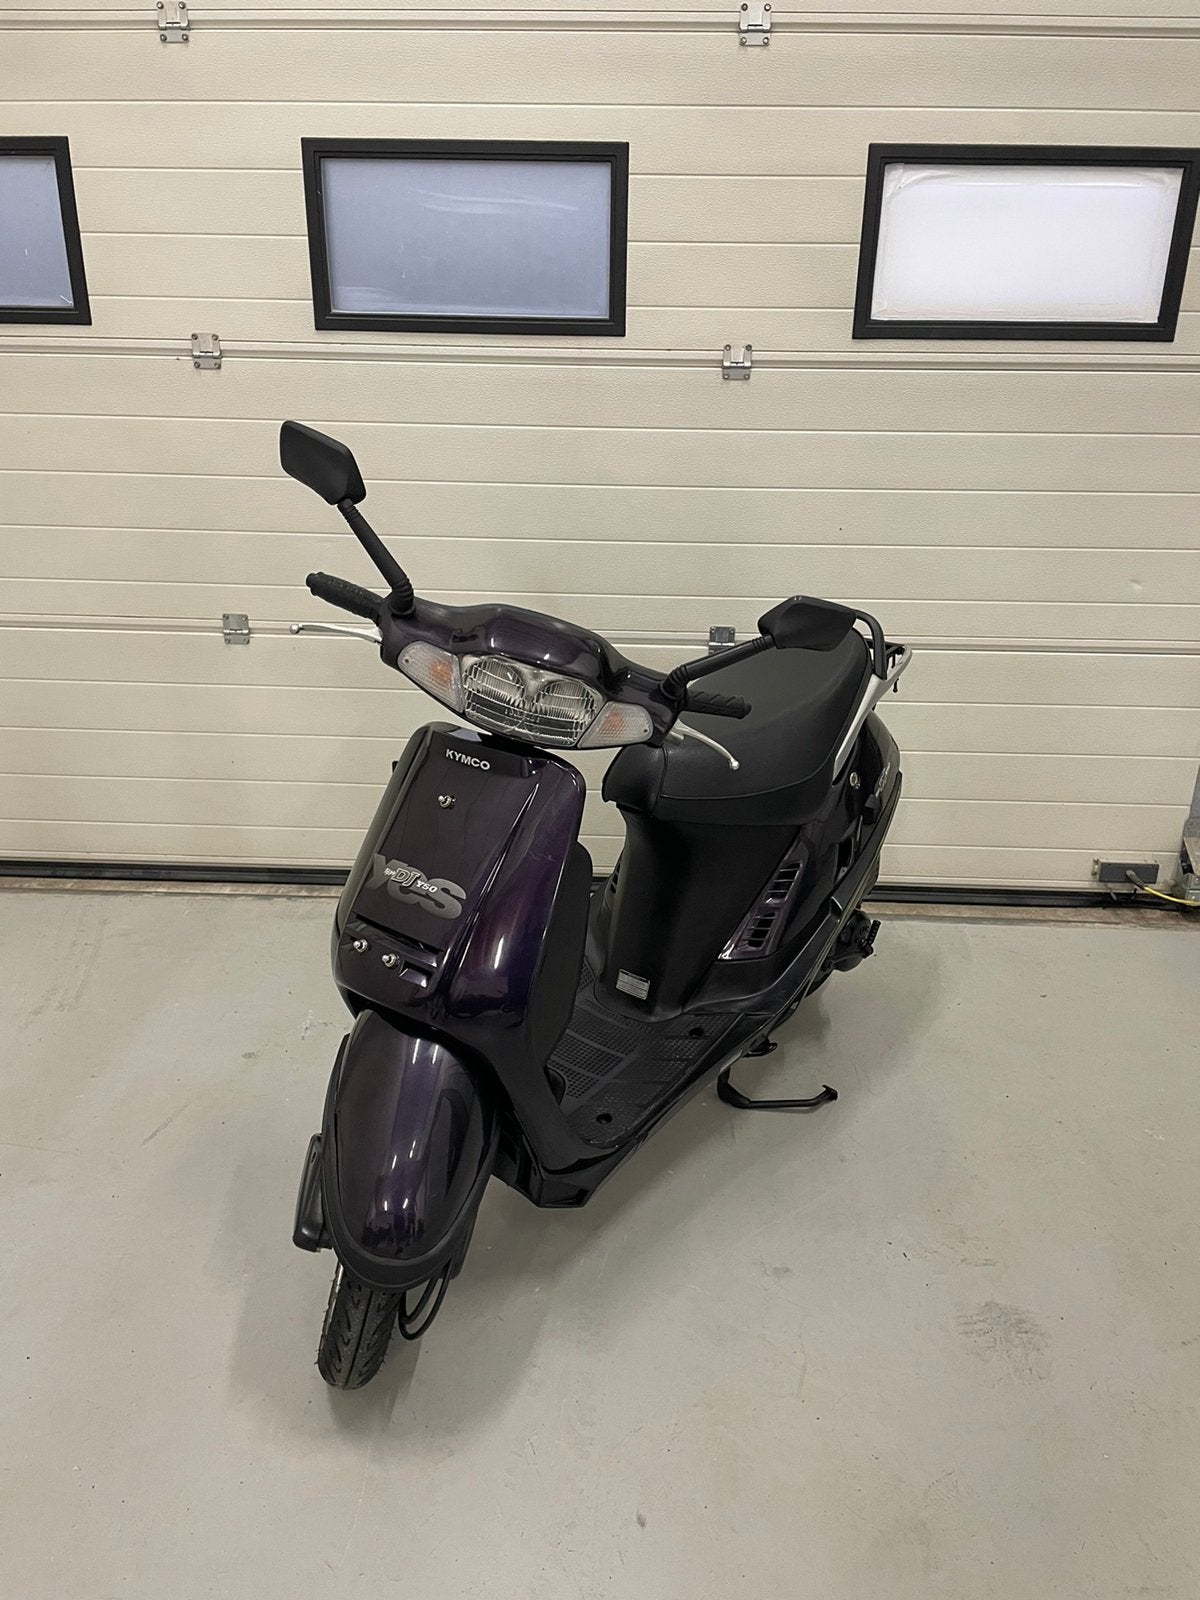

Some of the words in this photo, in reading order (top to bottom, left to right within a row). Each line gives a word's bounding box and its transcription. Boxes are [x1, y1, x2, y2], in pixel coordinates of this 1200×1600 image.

[446, 749, 490, 770] KYMCO
[391, 867, 421, 887] DJ
[416, 880, 438, 893] Y50
